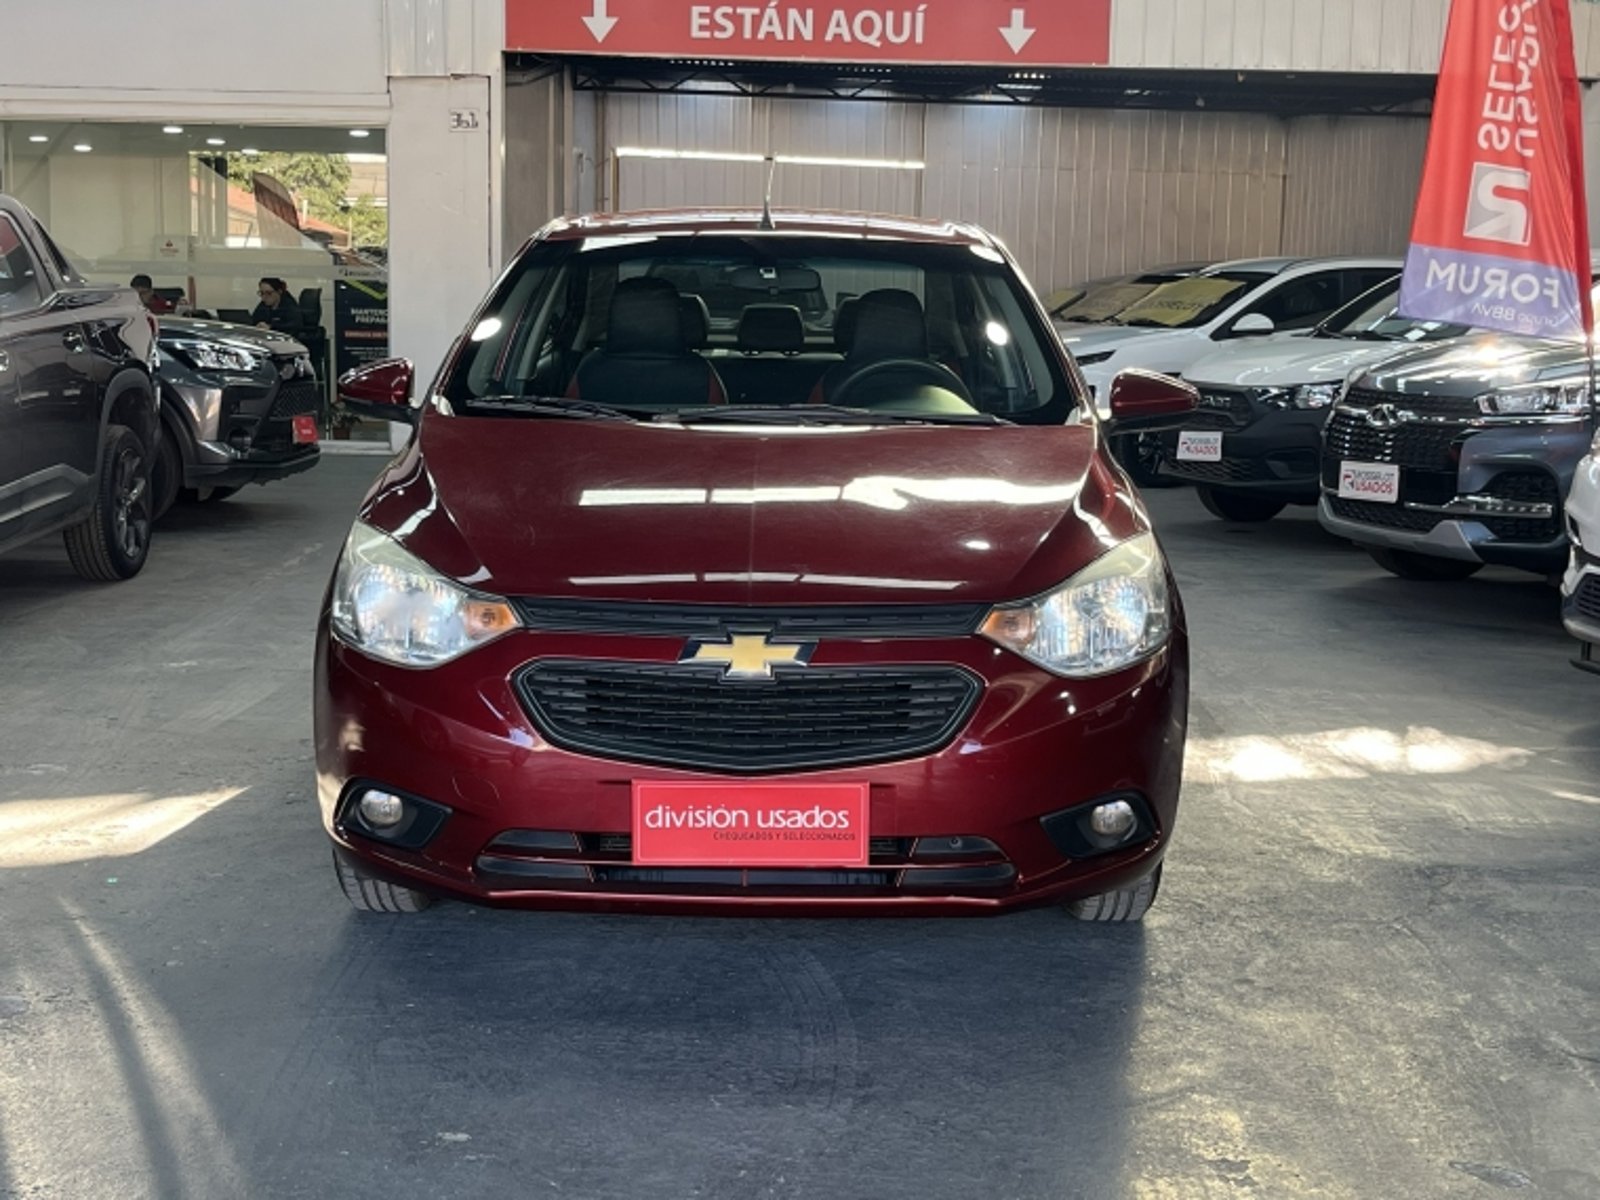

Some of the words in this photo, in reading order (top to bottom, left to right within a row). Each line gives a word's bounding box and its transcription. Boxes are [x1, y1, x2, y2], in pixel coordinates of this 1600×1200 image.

[690, 0, 815, 41] ESTÁN
[824, 4, 928, 48] AQUÍ
[645, 803, 749, 829] división
[756, 804, 849, 829] usados
[713, 832, 774, 841] CHEQUEADOS
[783, 832, 856, 841] SELECCIONADOS
